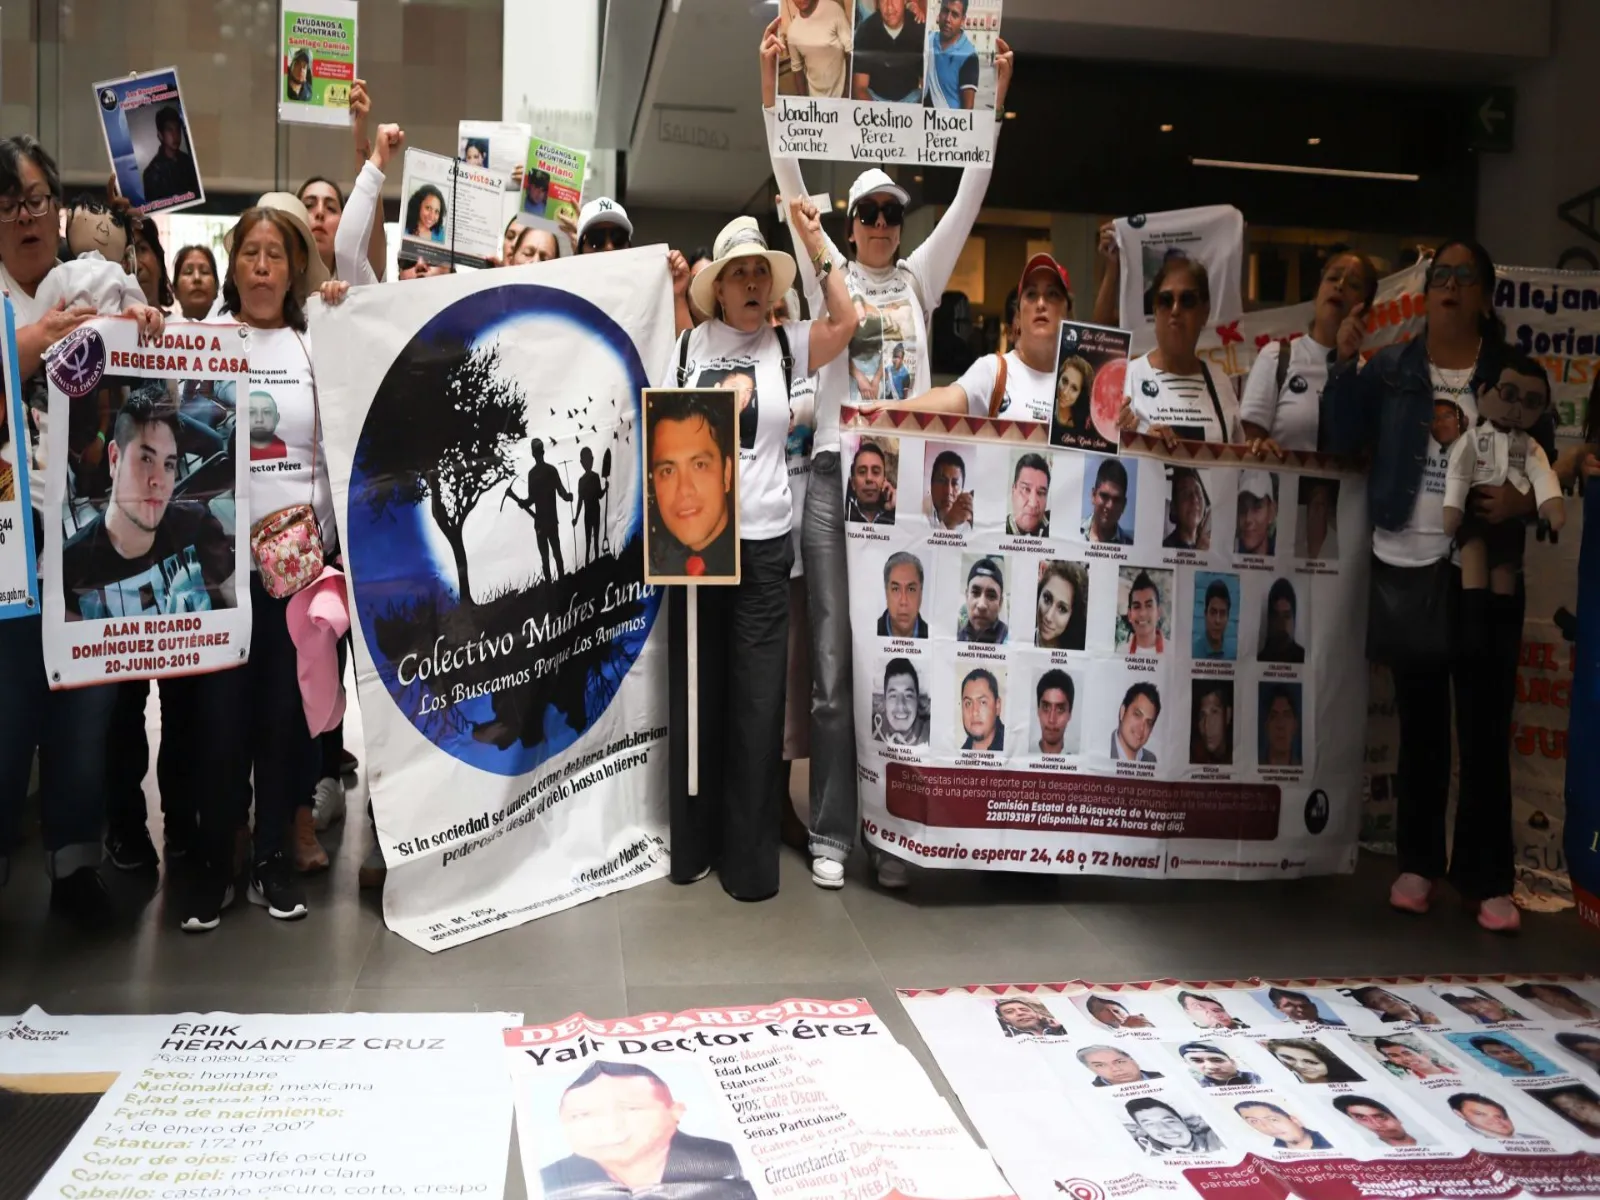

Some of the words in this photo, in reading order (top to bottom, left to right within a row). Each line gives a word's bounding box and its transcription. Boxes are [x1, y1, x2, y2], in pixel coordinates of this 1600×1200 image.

[293, 25, 346, 38] ENCONTRARLO
[296, 18, 336, 29] AYUDANOS
[288, 37, 321, 48] Santiago
[778, 100, 839, 124] Jonathan
[853, 107, 913, 129] Celestino
[923, 110, 974, 131] Misael
[787, 124, 823, 138] Garay
[861, 127, 895, 144] Pérez
[925, 131, 958, 148] Pérez
[538, 143, 571, 160] AYUDANOS
[572, 154, 577, 162] A
[778, 135, 828, 153] Sánchez
[535, 151, 579, 170] ENCONTRARLO
[538, 160, 574, 179] Mariano
[1495, 279, 1600, 315] Alejan
[110, 351, 187, 371] REGRESAR
[192, 356, 203, 372] A
[208, 356, 250, 373] CASA
[933, 532, 963, 540] ALEJANDRO
[1012, 538, 1043, 546] ALEJANDRO
[1090, 544, 1122, 552] ALEXANDER
[103, 622, 140, 638] ALAN
[144, 618, 202, 635] RICARDO
[396, 630, 515, 687] Colectivo
[521, 592, 595, 649] Madres
[600, 580, 657, 613] Luna
[72, 640, 154, 660] DOMÍNGUEZ
[158, 632, 230, 651] GUTIÉRREZ
[105, 652, 200, 674] 20-JUNIO-2019
[418, 693, 447, 716] Los
[451, 668, 531, 705] Buscamos
[534, 648, 570, 679] Porque
[571, 634, 592, 656] Los
[595, 615, 646, 647] Amamos
[891, 780, 931, 797] paradero
[932, 787, 944, 796] de
[945, 788, 961, 797] una
[962, 788, 997, 799] persona
[998, 789, 1040, 803] reportada
[1041, 793, 1067, 803] como
[901, 770, 909, 780] Si
[912, 773, 952, 786] necesitas
[953, 775, 978, 786] iniciar
[980, 776, 988, 787] el
[990, 777, 1021, 789] reporte
[1022, 779, 1037, 790] por
[1038, 778, 1047, 789] la
[1047, 779, 1102, 794] desaparición
[1104, 781, 1115, 792] de
[1117, 784, 1135, 794] una
[414, 836, 430, 853] la
[431, 812, 490, 847] sociedad
[563, 748, 604, 777] debiera
[987, 799, 1029, 811] Comisión
[1031, 802, 1064, 813] Estatal
[1066, 803, 1078, 814] de
[1079, 804, 1127, 818] Búsqueda
[1129, 807, 1143, 819] de
[1144, 808, 1187, 821] Veracruz:
[985, 811, 1036, 824] 2283193187
[1037, 813, 1088, 827] (disponible
[1090, 817, 1105, 827] las
[1106, 817, 1119, 828] 24
[1120, 818, 1148, 831] horas
[1150, 820, 1166, 831] del
[880, 829, 897, 843] es
[898, 835, 968, 860] necesario
[971, 847, 1027, 865] esperar
[1029, 849, 1052, 865] 24,
[1056, 849, 1075, 864] 48
[1091, 852, 1109, 866] 72
[1112, 854, 1161, 869] horas!
[171, 1023, 243, 1037] ERIK
[160, 1037, 356, 1051] HERNÁNDEZ
[363, 1038, 447, 1050] CRUZ
[618, 1031, 754, 1055] Dector
[708, 1053, 739, 1066] Sexo:
[740, 1044, 794, 1062] Masculino
[141, 1067, 195, 1080] Sexo:
[200, 1070, 278, 1080] hombre
[714, 1065, 742, 1078] Edad
[744, 1057, 782, 1074] Actual:
[133, 1081, 274, 1092] Nacionalidad:
[279, 1081, 374, 1092] mexicana
[720, 1075, 769, 1090] Estatura:
[770, 1066, 793, 1080] 1.55
[113, 1108, 178, 1121] Fecha
[185, 1108, 211, 1119] de
[217, 1106, 345, 1119] nacimiento:
[104, 1122, 124, 1135] 14
[130, 1120, 157, 1133] de
[163, 1124, 224, 1135] enero
[230, 1123, 257, 1134] de
[262, 1120, 315, 1133] 2007
[744, 1123, 779, 1139] Señas
[779, 1111, 848, 1132] Particulares
[92, 1136, 194, 1149] Estatura:
[199, 1138, 236, 1149] 1.72
[241, 1140, 263, 1149] m
[83, 1151, 143, 1166] Color
[150, 1154, 177, 1165] de
[184, 1154, 238, 1167] ojos:
[243, 1151, 289, 1164] café
[295, 1151, 367, 1163] oscuro
[764, 1147, 850, 1186] Circunstancia:
[71, 1168, 133, 1182] Color
[138, 1170, 168, 1182] de
[174, 1169, 225, 1184] piel:
[231, 1168, 317, 1180] morena
[324, 1167, 376, 1179] clara
[1199, 1175, 1261, 1191] paradero
[1304, 1172, 1360, 1185] persona
[59, 1184, 156, 1200] Cabello:
[162, 1185, 251, 1199] castaño
[258, 1183, 337, 1196] oscuro,
[344, 1184, 406, 1195] corto,
[413, 1182, 488, 1195] crespo
